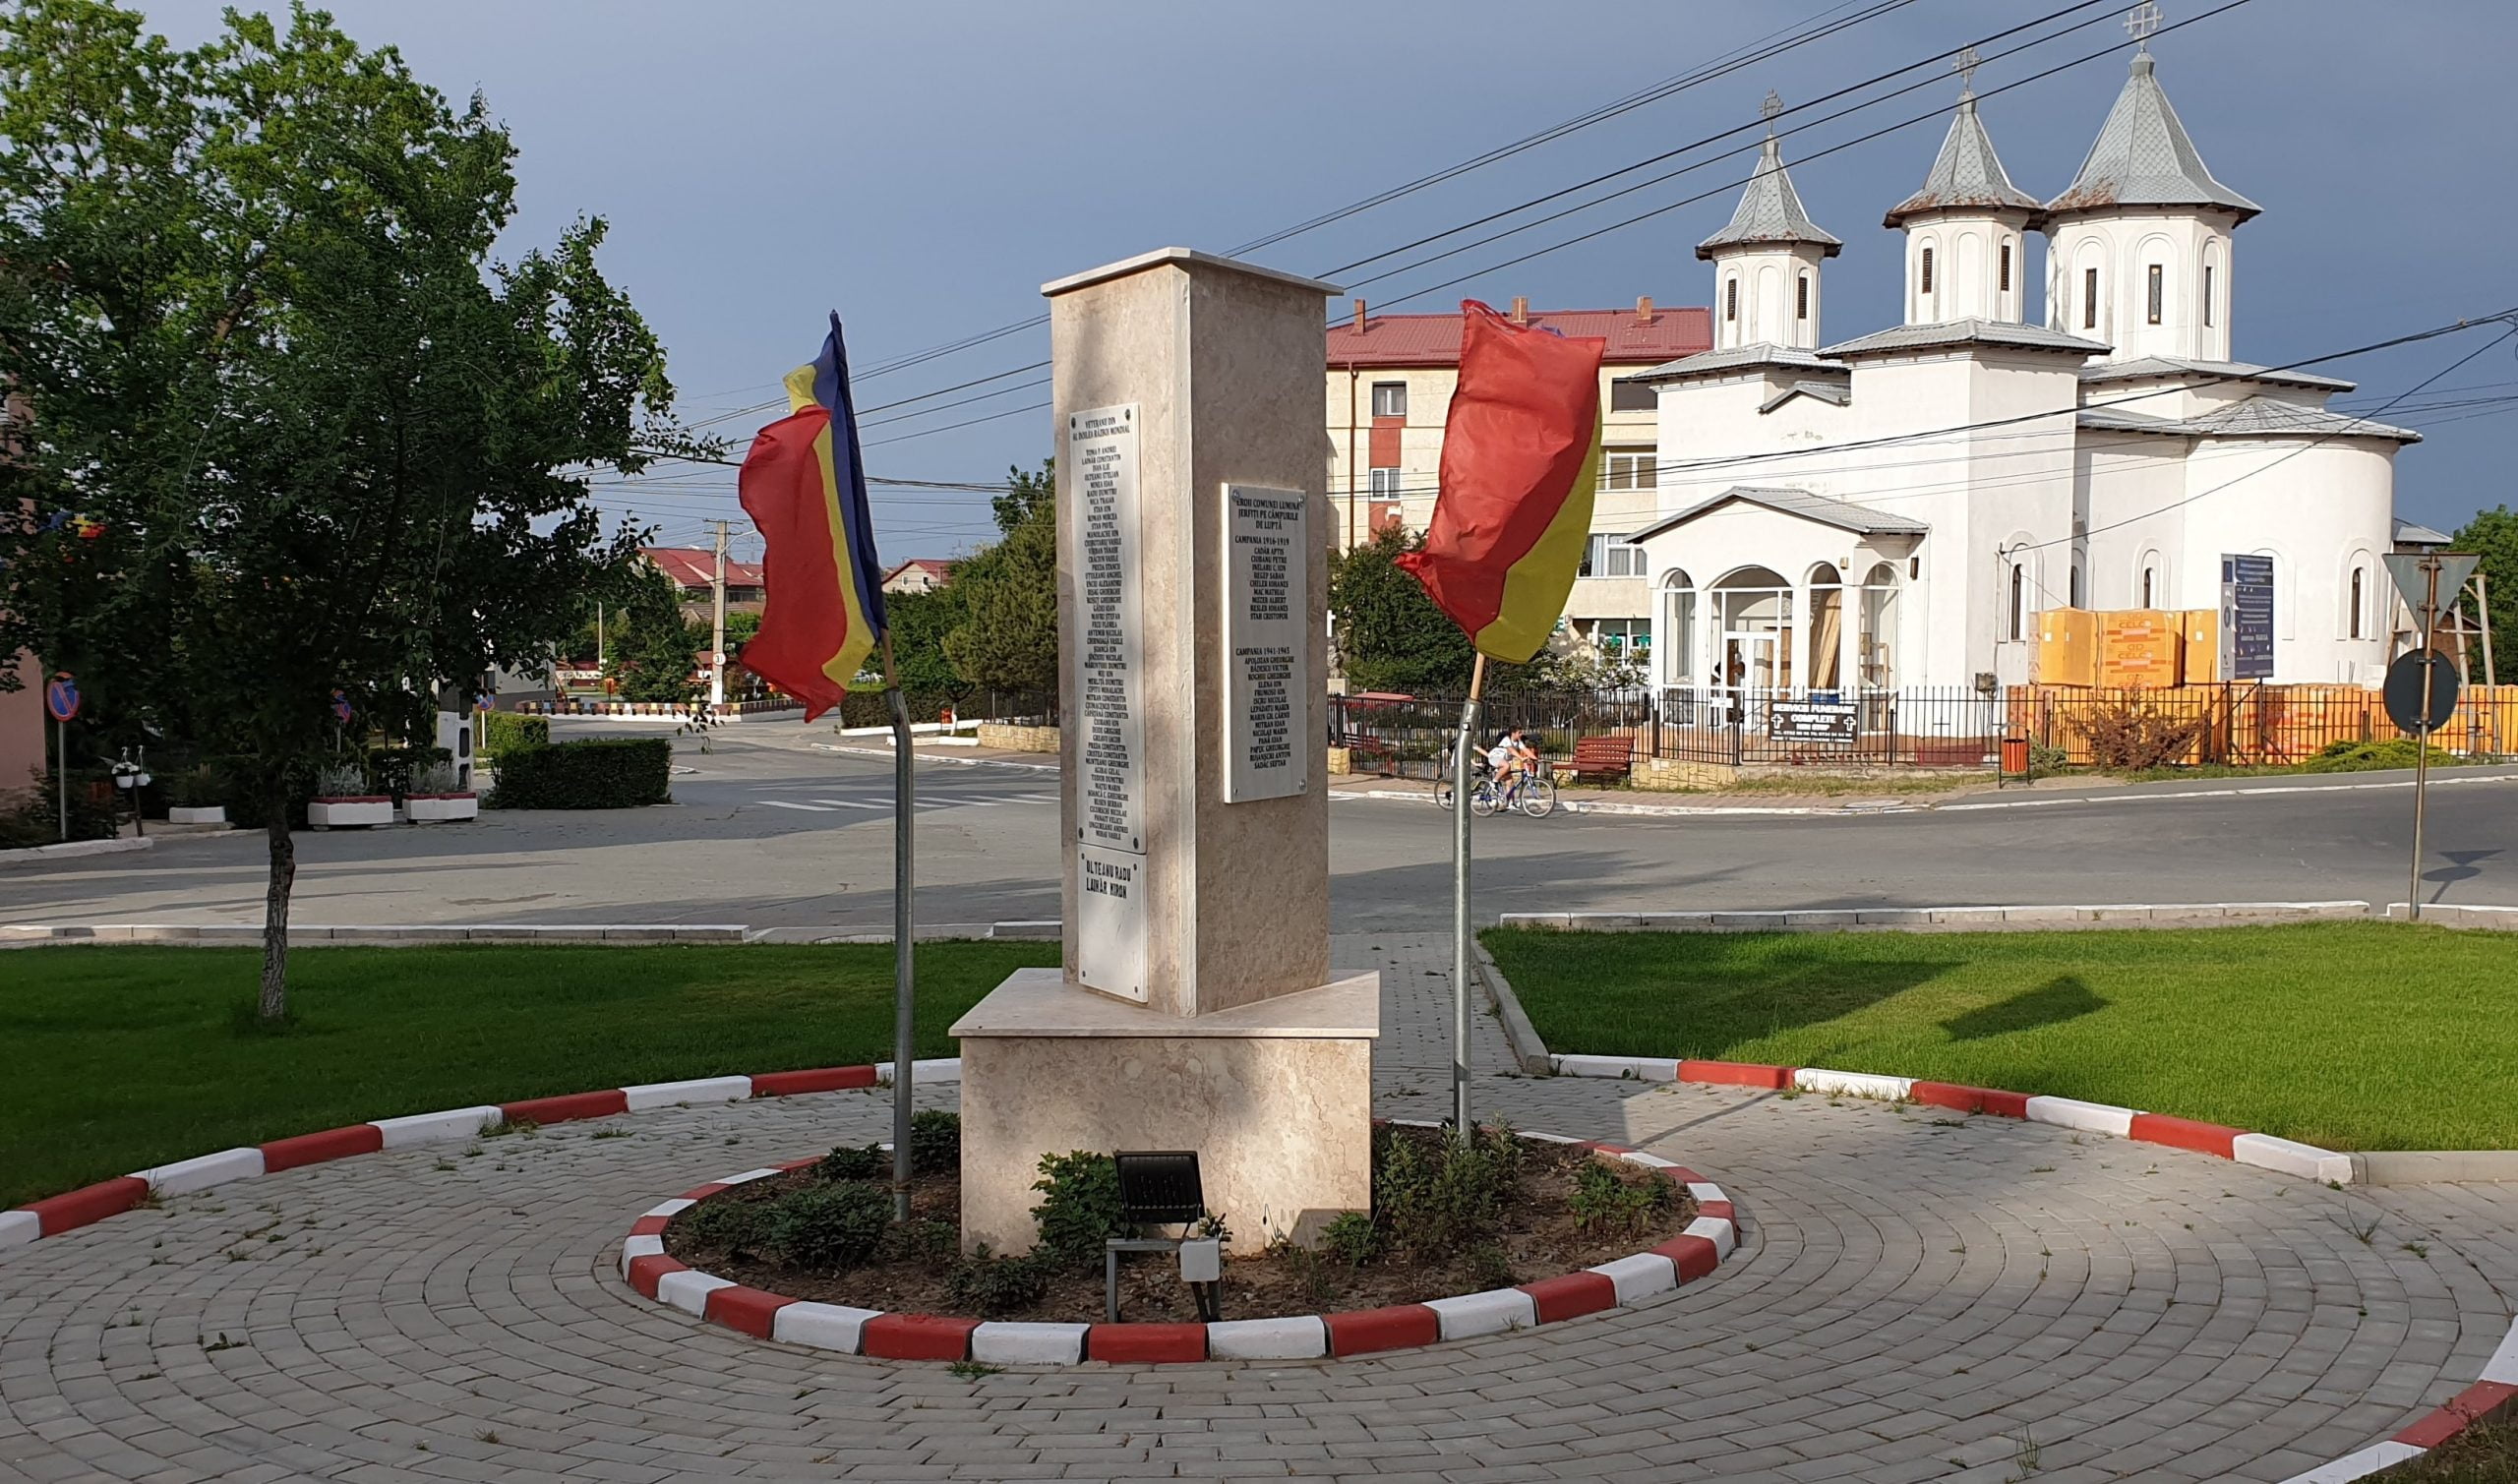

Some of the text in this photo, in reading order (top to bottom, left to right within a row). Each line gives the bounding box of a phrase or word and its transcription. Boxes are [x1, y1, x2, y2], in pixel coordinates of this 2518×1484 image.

[1235, 535, 1262, 545] CAMPANIA
[1236, 647, 1263, 656] CAMPANIA
[1790, 714, 1836, 723] COMPLETE
[1086, 860, 1130, 881] OLTEANU RADU
